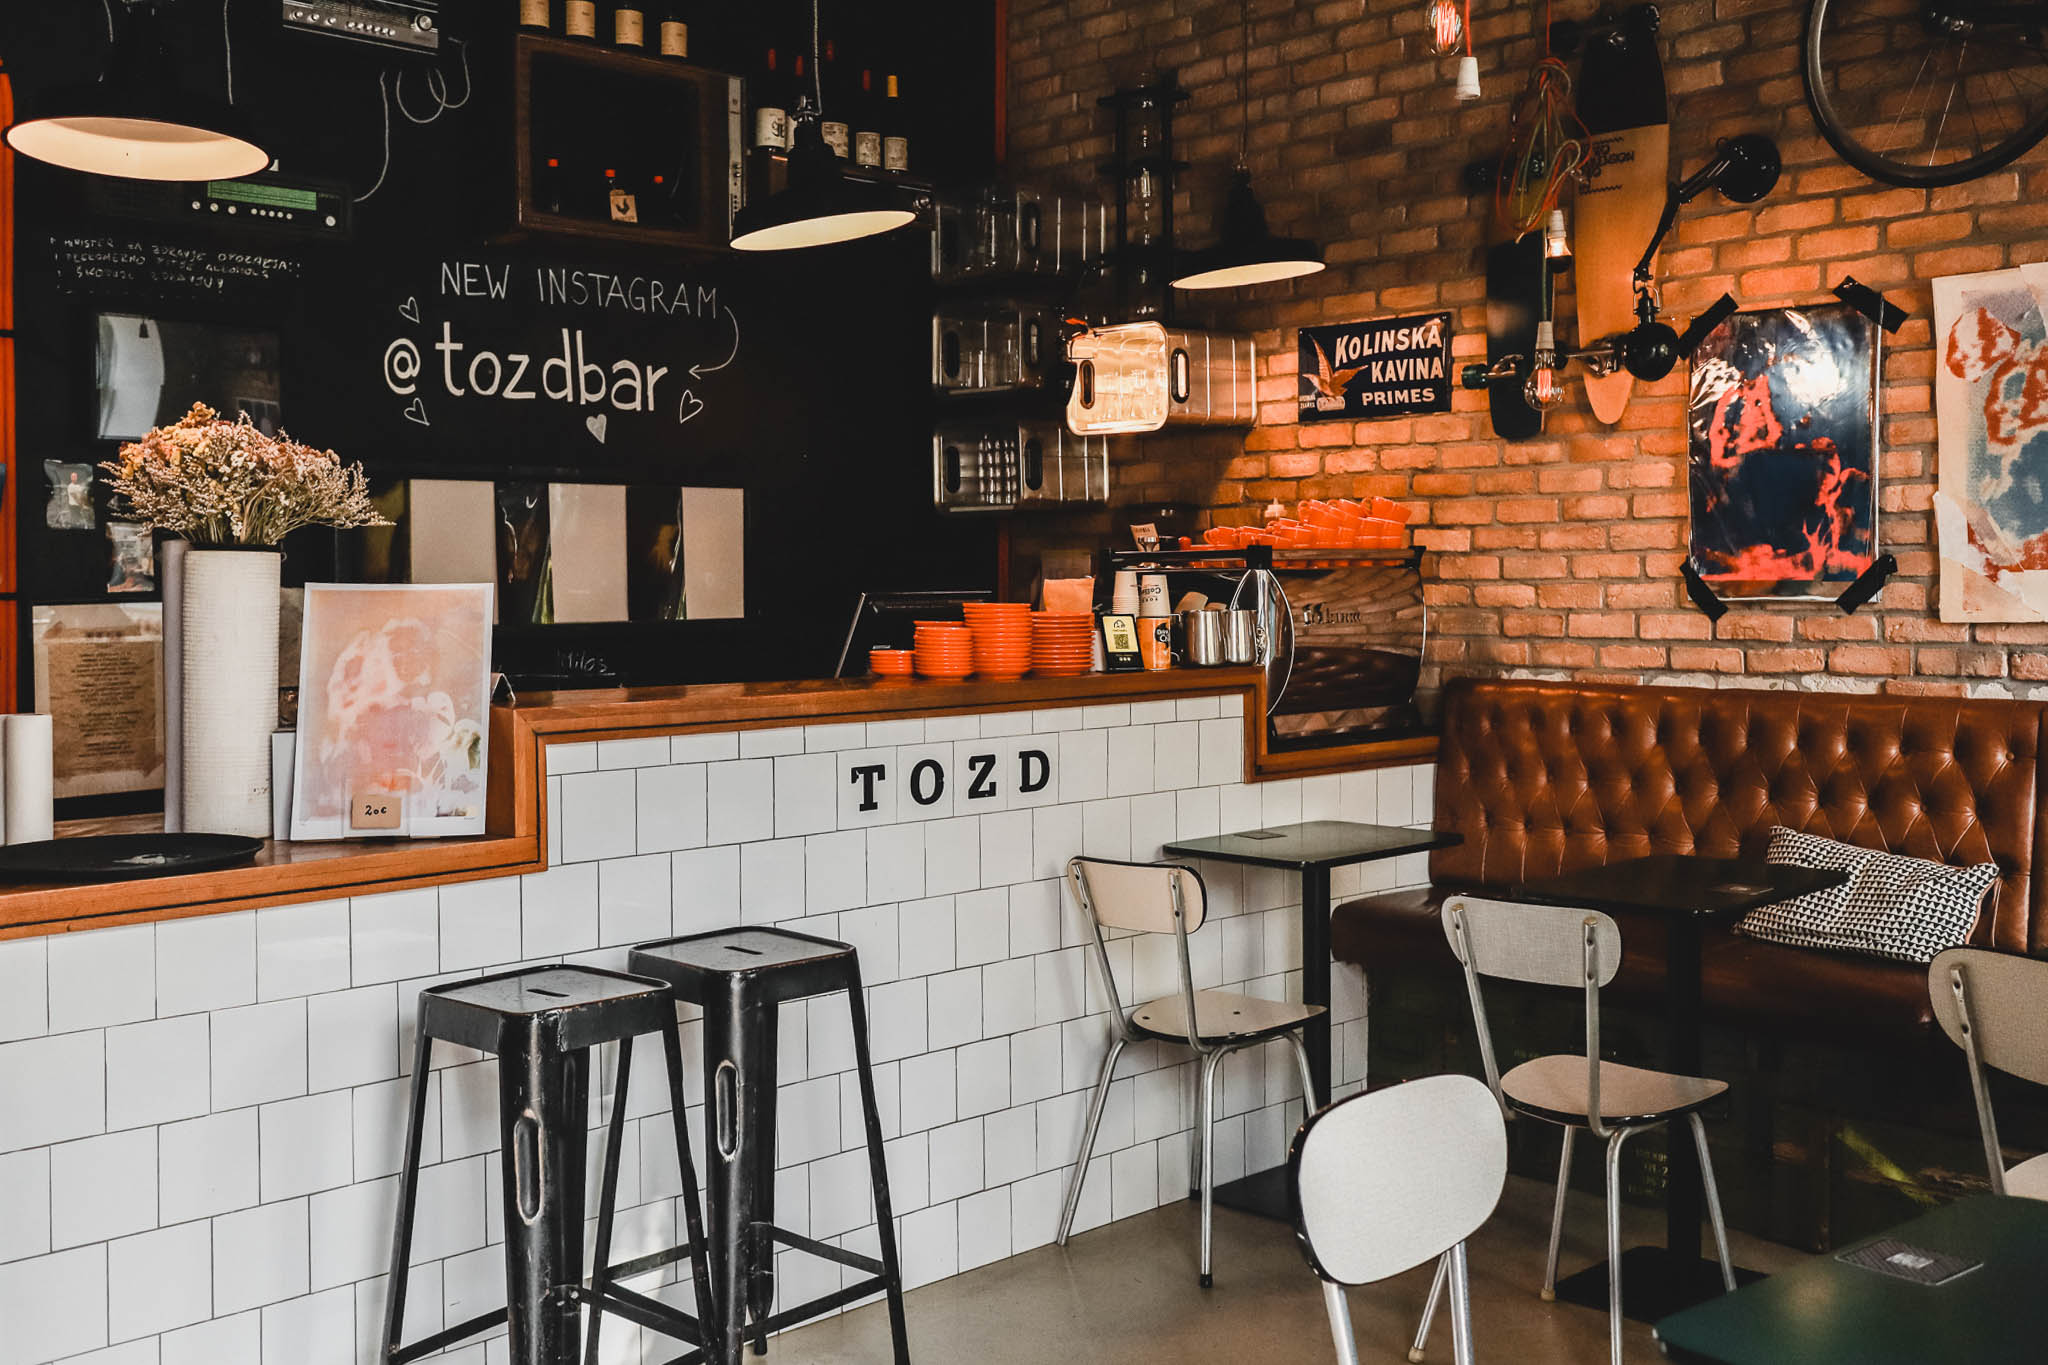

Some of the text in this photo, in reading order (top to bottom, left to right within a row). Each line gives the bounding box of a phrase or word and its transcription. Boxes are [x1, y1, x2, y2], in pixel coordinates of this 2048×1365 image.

[440, 261, 718, 319] NEW INSTAGRAM
[383, 321, 669, 412] @tozdbar
[1336, 326, 1442, 367] KOLINSKA
[1371, 357, 1443, 383] KAVINA
[1362, 388, 1435, 405] PRIMES
[851, 750, 1051, 812] TOZD
